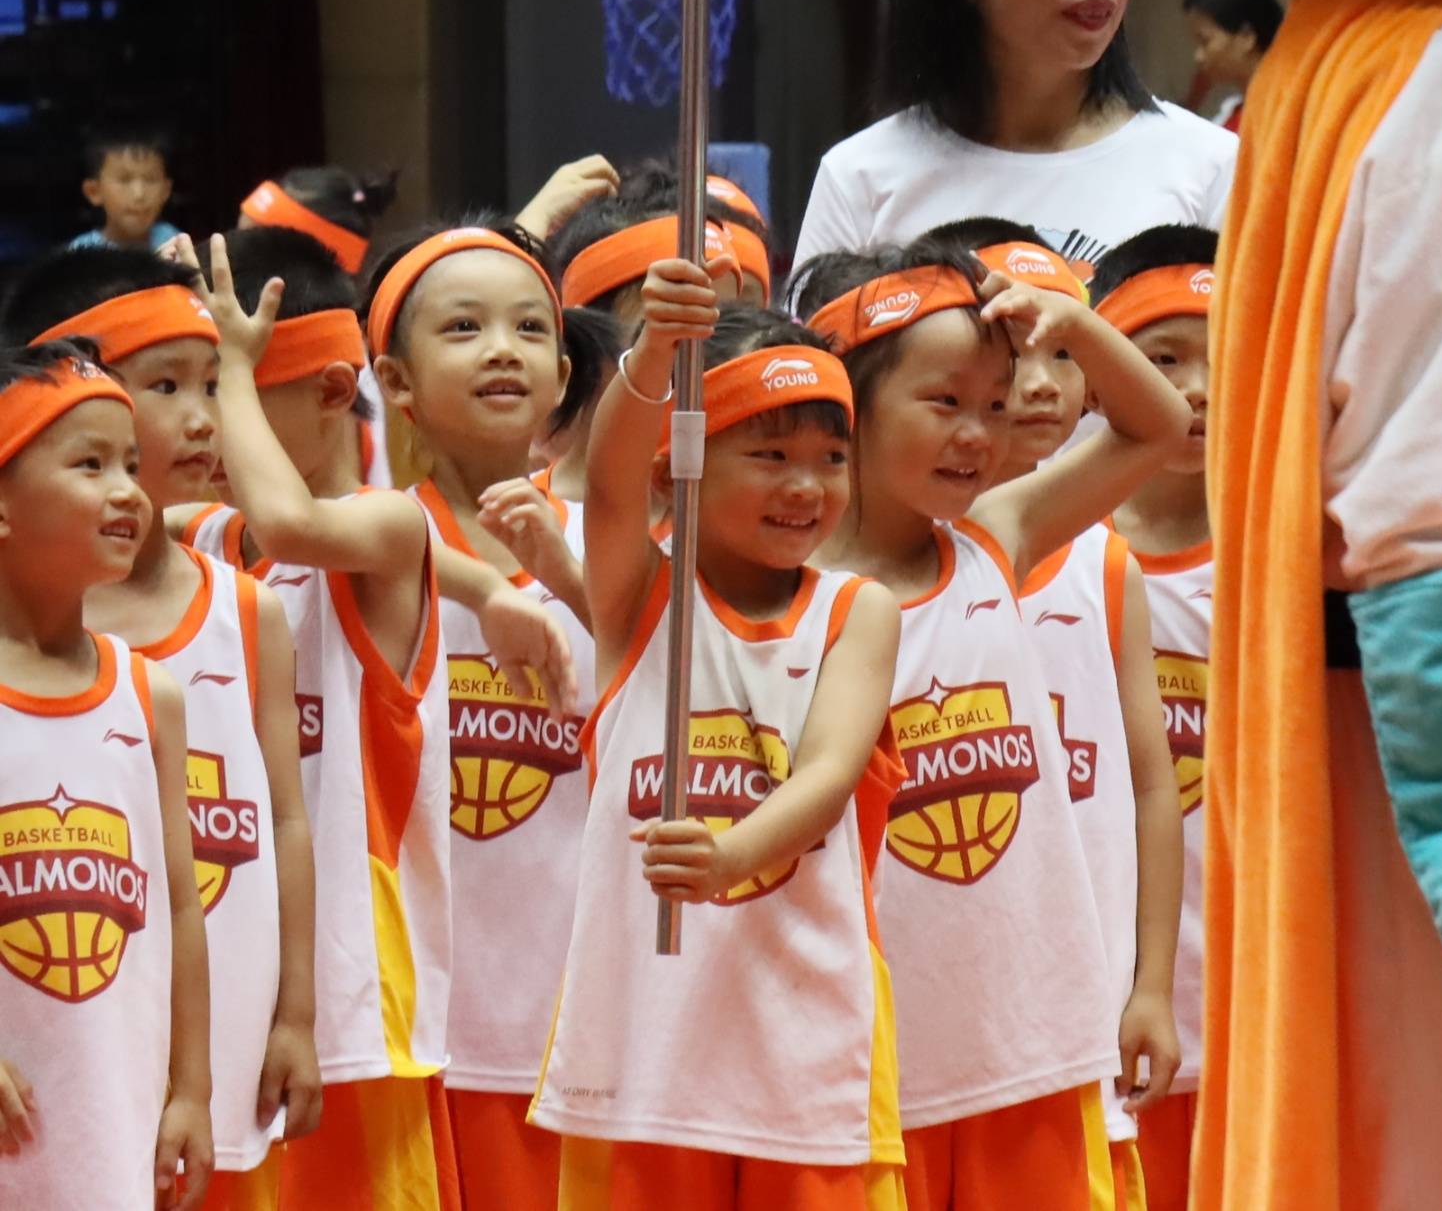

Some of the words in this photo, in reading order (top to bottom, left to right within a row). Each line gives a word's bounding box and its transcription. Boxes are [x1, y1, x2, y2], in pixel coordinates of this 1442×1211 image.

[1009, 261, 1056, 276] YOUNG
[864, 290, 920, 319] YOUNG
[763, 372, 819, 393] YOUNG
[3, 827, 114, 848] BASKETBALL
